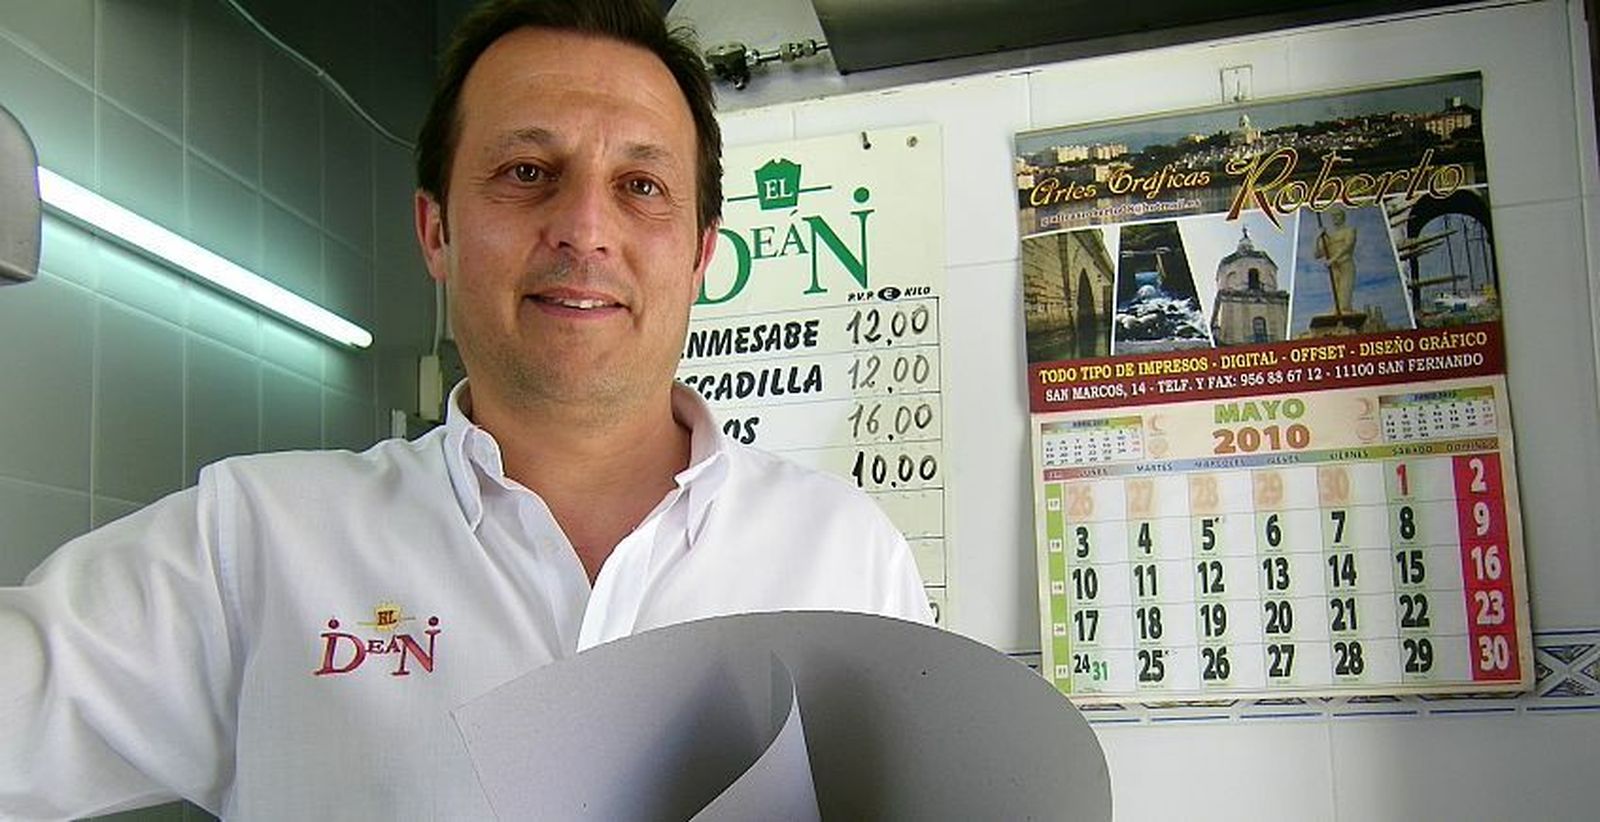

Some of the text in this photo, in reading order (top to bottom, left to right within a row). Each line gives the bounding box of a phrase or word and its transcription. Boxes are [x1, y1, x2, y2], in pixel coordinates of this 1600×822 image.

[763, 178, 794, 200] EL
[1030, 178, 1097, 206] Artes
[1225, 147, 1465, 234] Roberto
[680, 319, 820, 358] NMESABE
[1039, 330, 1488, 384] TODO TIPO DE IMPRESOS DIGITAL OFFSET DISEÑO GRÁFICO
[1046, 388, 1070, 402] SAN
[1073, 384, 1128, 401] MARCOS,
[1131, 382, 1146, 396] 14
[1158, 378, 1194, 394] TELF.
[1196, 377, 1206, 391] Y
[1208, 375, 1237, 391] FAX:
[1240, 373, 1265, 388] 956
[1287, 368, 1302, 383] 67
[1307, 367, 1323, 381] 12
[1335, 362, 1375, 379] 11100
[1378, 359, 1405, 375] SAN
[1408, 353, 1484, 373] FERNANDO
[1214, 398, 1306, 424] MAYO
[1212, 424, 1311, 454] 2010
[1396, 463, 1409, 496] 1
[1468, 457, 1488, 493] 2
[1075, 526, 1090, 558] 3
[1137, 522, 1153, 554] 4
[1202, 519, 1216, 551] 5
[1266, 514, 1282, 547] 6
[1331, 510, 1346, 543] 7
[1400, 506, 1416, 540] 8
[1472, 501, 1491, 536] 9
[1072, 567, 1098, 600] 10
[1133, 564, 1158, 597] 11
[1197, 560, 1225, 594] 12
[1262, 557, 1290, 590] 13
[1328, 553, 1358, 587] 14
[1395, 550, 1426, 584] 15
[1471, 545, 1501, 581] 16
[377, 610, 398, 626] EL
[1074, 610, 1099, 642] 17
[1136, 606, 1163, 640] 18
[1200, 602, 1228, 637] 19
[1264, 600, 1293, 634] 20
[1330, 597, 1357, 631] 21
[1399, 593, 1431, 628] 22
[1474, 590, 1505, 625] 23
[1073, 653, 1091, 674] 24
[1092, 660, 1109, 681] 31
[1138, 649, 1165, 682] 25
[1202, 646, 1231, 680] 26
[1267, 643, 1295, 677] 27
[1334, 641, 1364, 675] 28
[1403, 638, 1433, 673] 29
[1478, 634, 1509, 671] 30
